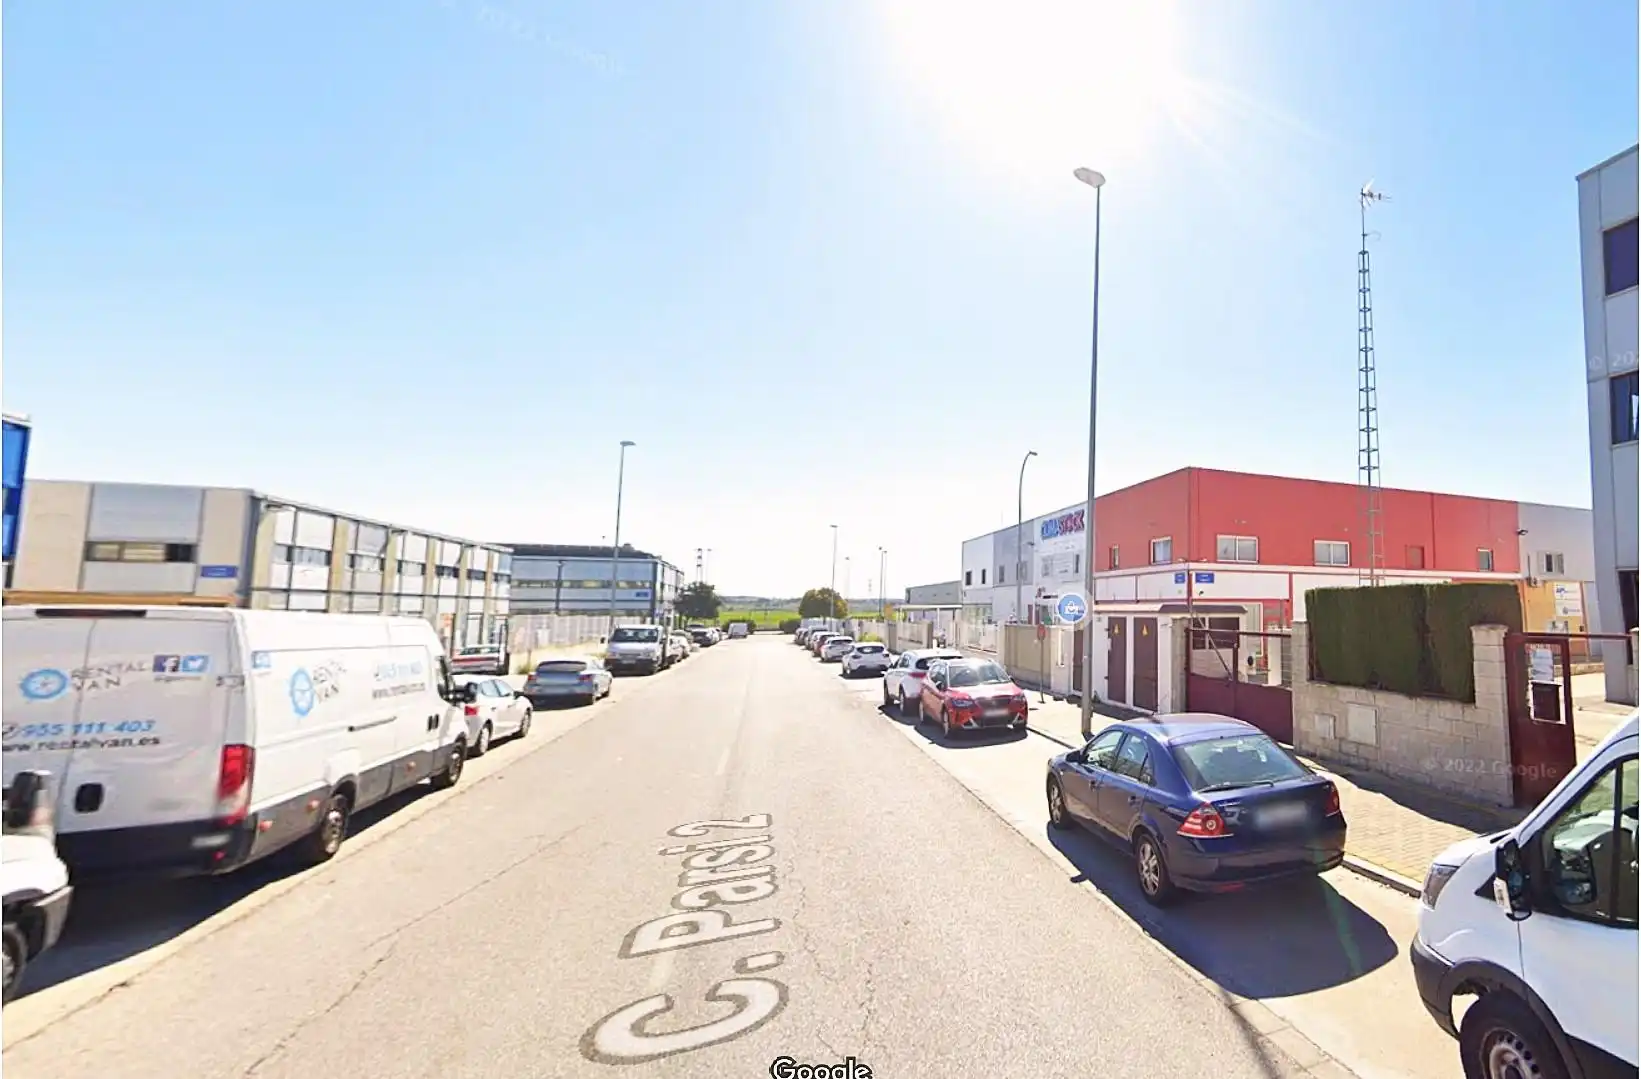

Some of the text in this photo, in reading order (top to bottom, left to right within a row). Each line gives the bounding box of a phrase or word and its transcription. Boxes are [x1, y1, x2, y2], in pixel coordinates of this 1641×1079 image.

[73, 676, 122, 692] VAN
[22, 719, 156, 737] 955 111 403
